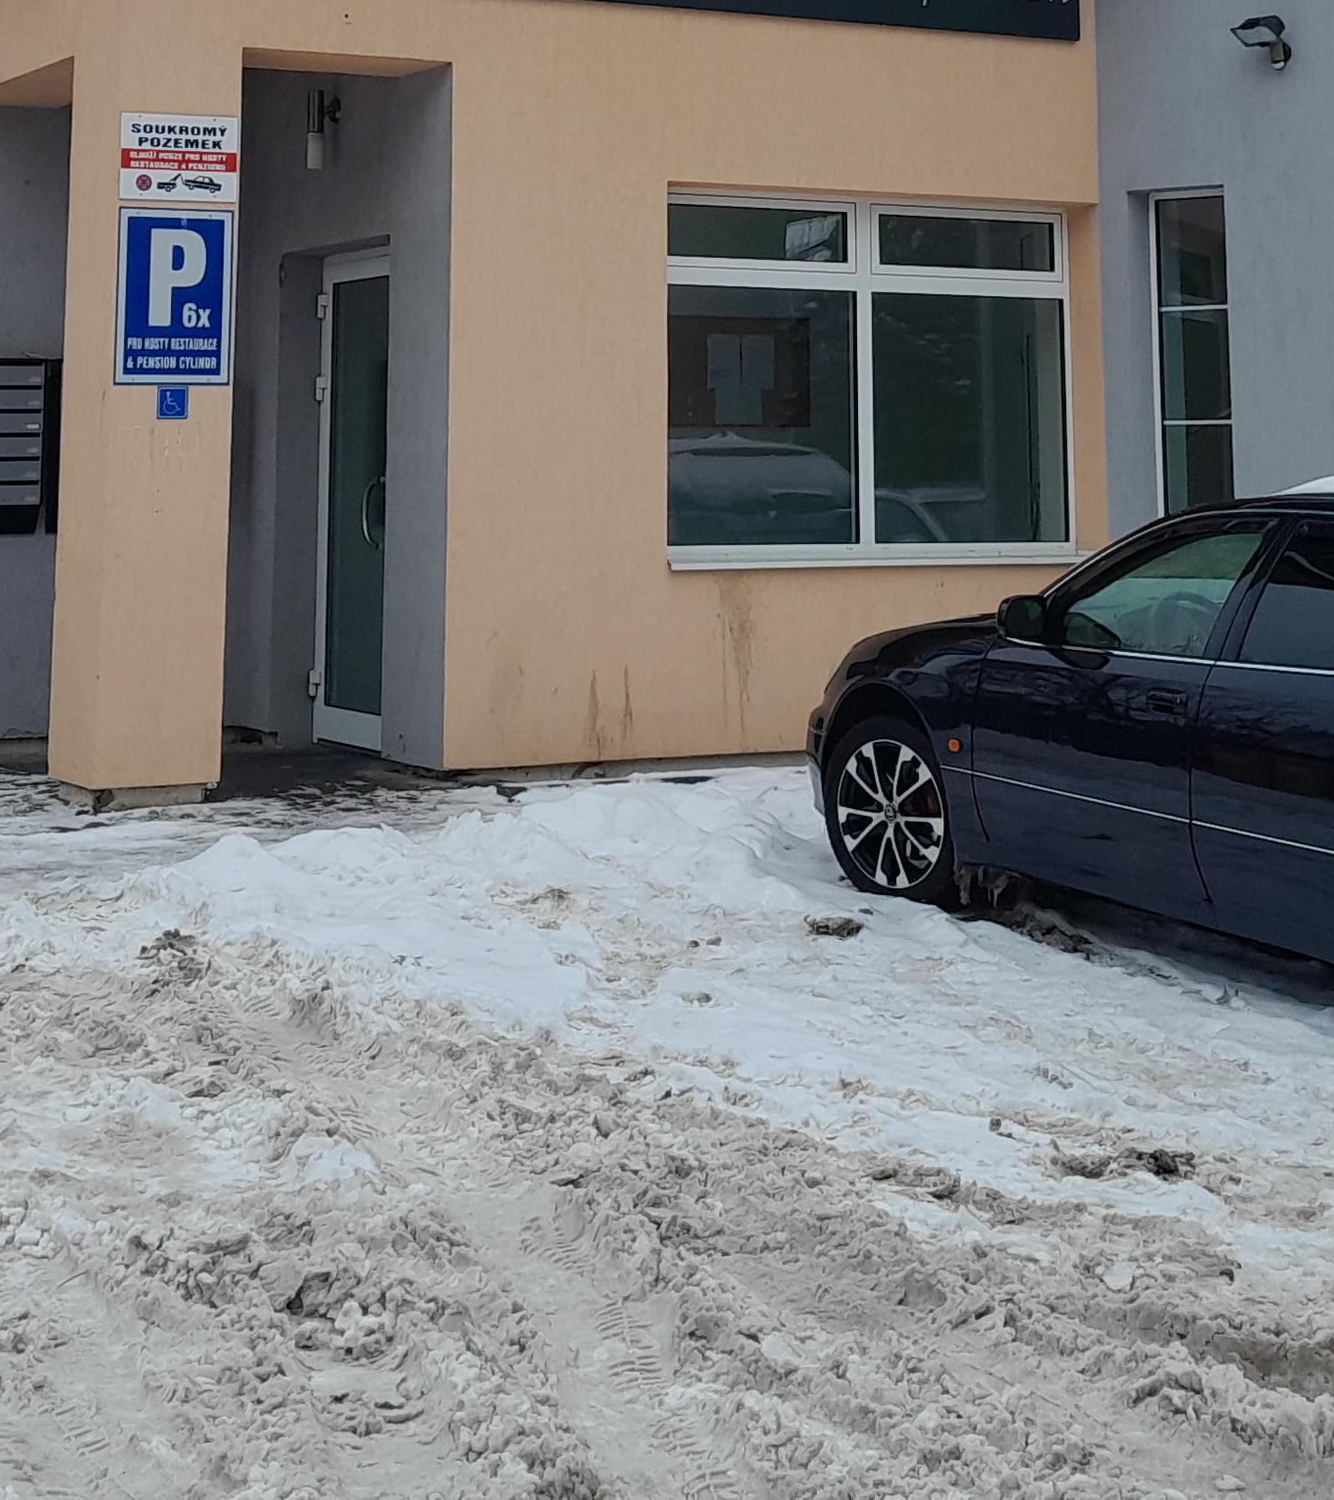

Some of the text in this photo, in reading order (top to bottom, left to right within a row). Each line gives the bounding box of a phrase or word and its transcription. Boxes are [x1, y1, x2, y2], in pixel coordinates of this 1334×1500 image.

[131, 123, 227, 137] SOUKROMÝ
[138, 136, 223, 150] POZEMEK
[147, 228, 207, 327] P
[182, 302, 212, 328] 6x
[127, 337, 218, 351] PRO HOSTY RESTAURACE
[127, 355, 217, 370] & PENSION CYLINDR
